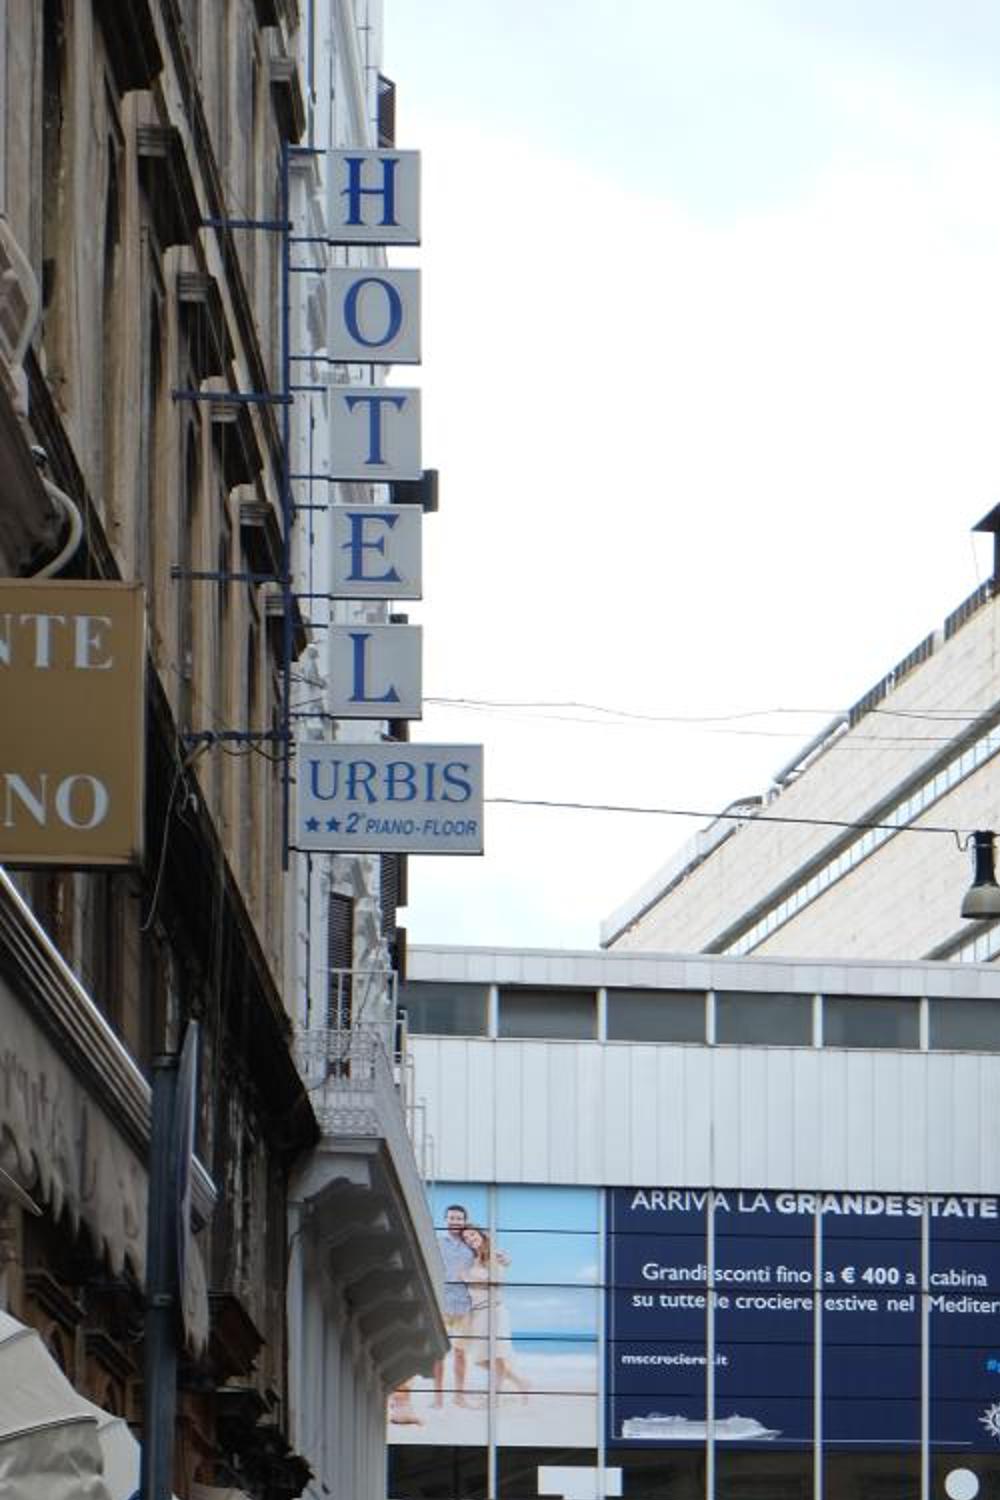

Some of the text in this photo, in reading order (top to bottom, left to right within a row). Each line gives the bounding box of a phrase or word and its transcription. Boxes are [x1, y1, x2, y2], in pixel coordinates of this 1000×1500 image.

[340, 157, 407, 703] HOTEL
[0, 614, 112, 668] TE
[309, 759, 472, 803] URBIS
[631, 1190, 731, 1213] ARRIVA
[738, 1192, 771, 1213] LA
[642, 1263, 988, 1288] Grandi sconti fino a € 400 a cabina
[632, 1294, 654, 1308] su
[659, 1294, 706, 1309] tutte
[735, 1294, 813, 1311] crociere
[824, 1294, 879, 1312] estive
[886, 1295, 916, 1312] nel
